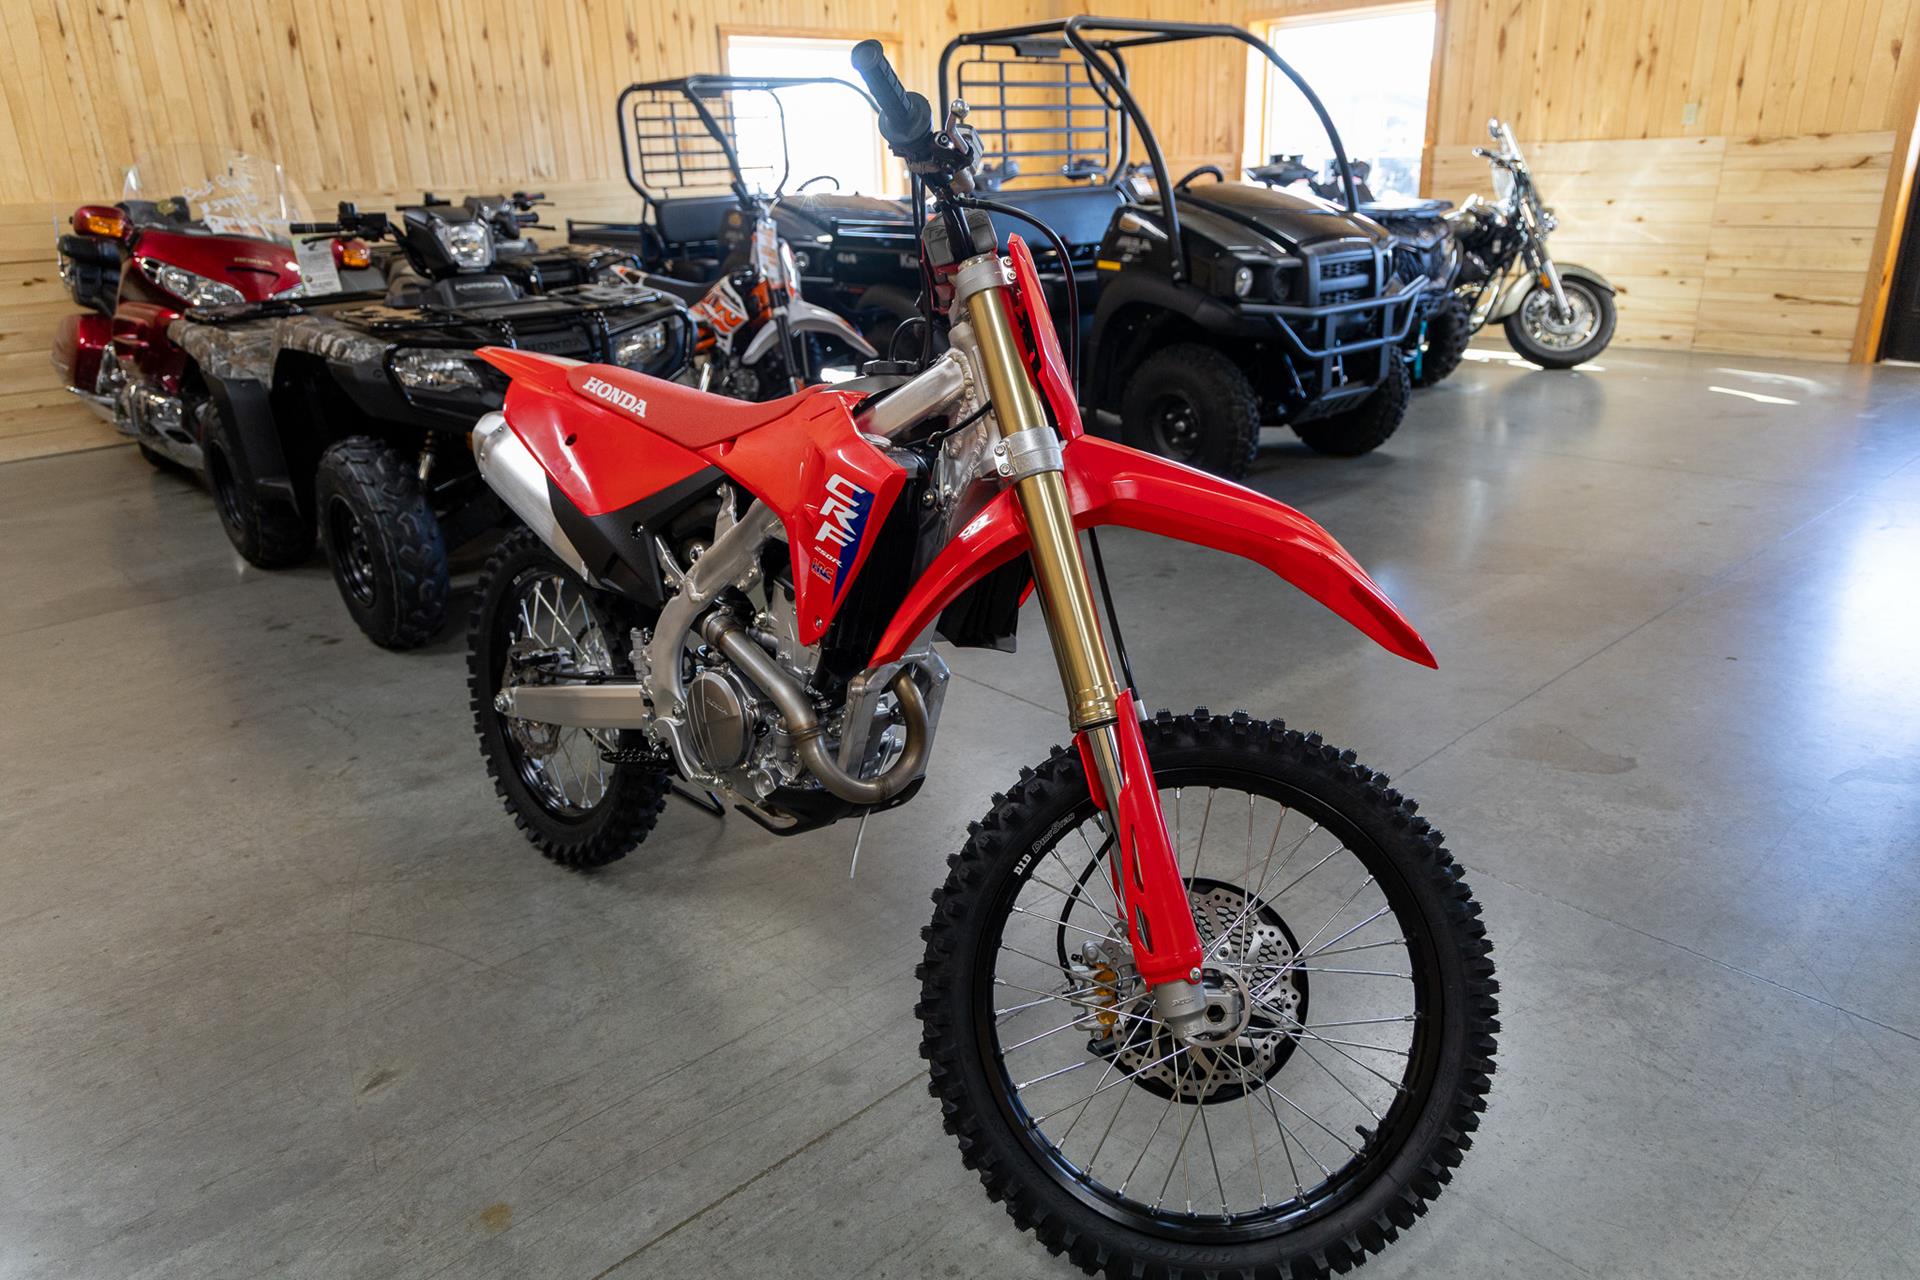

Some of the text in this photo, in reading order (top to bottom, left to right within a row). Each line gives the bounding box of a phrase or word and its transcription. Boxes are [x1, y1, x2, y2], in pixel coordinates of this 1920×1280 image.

[582, 376, 647, 418] HONDA
[815, 473, 867, 548] CRF
[814, 545, 843, 569] 250R
